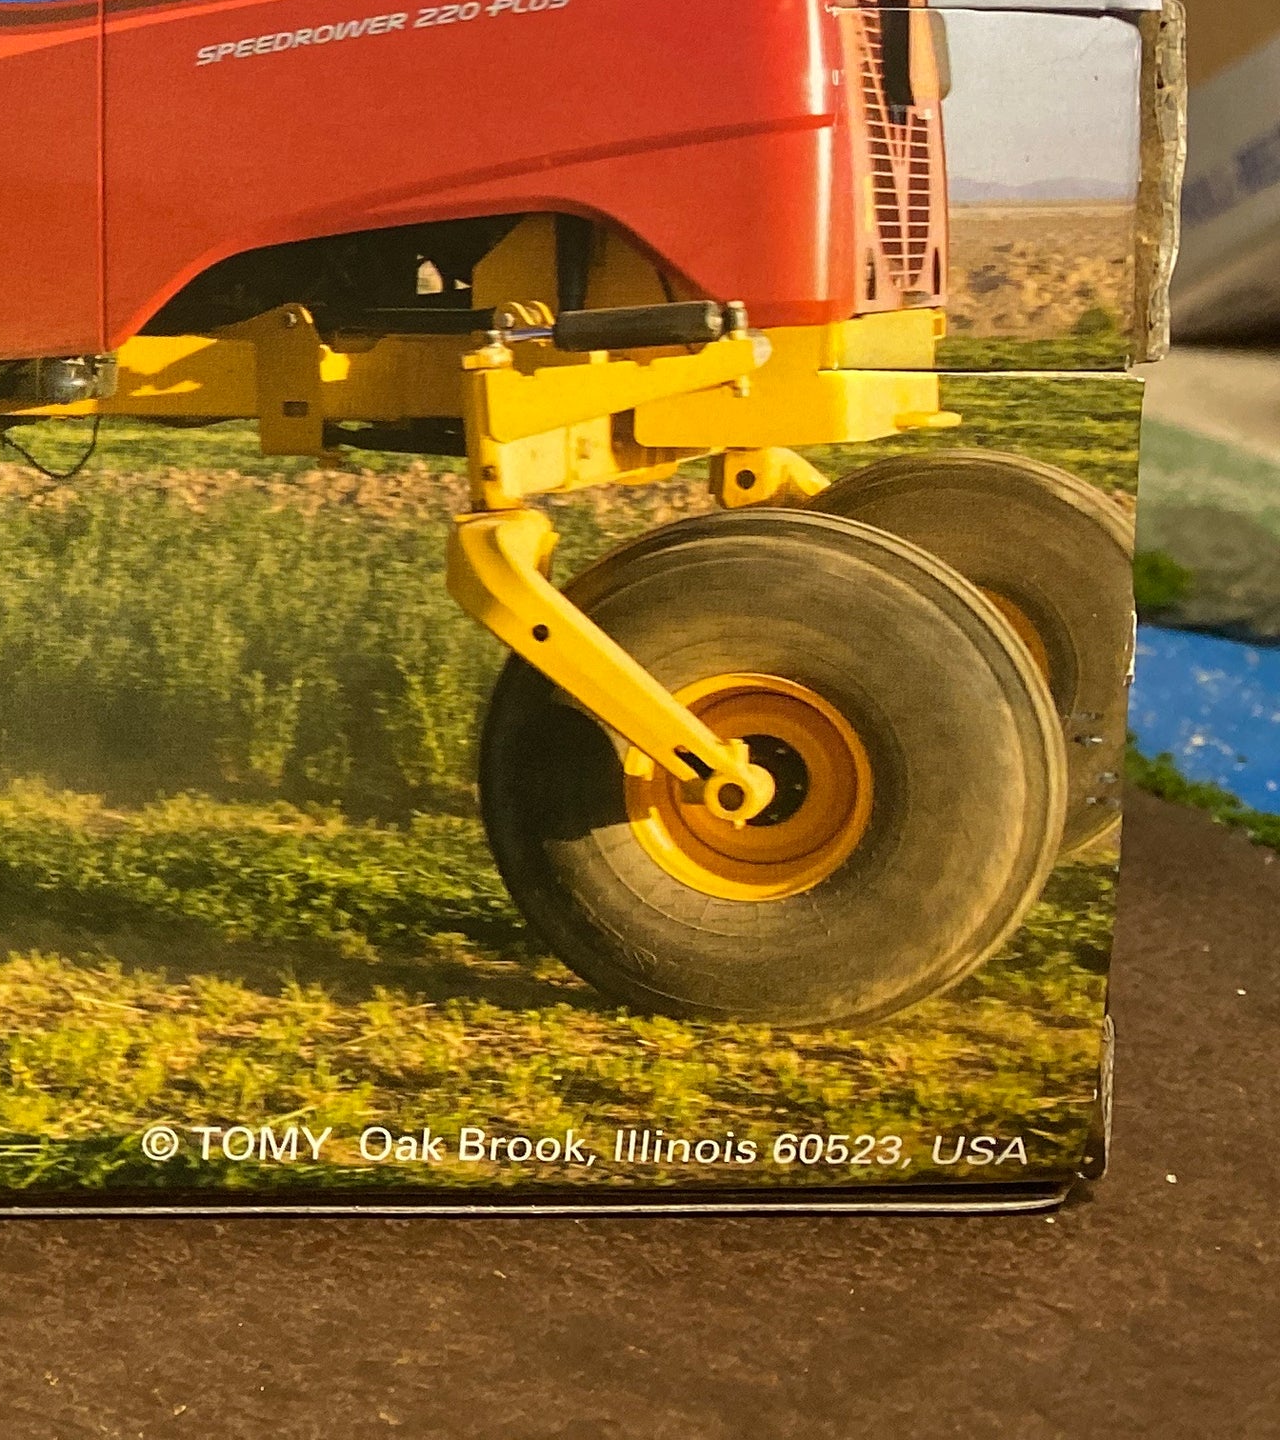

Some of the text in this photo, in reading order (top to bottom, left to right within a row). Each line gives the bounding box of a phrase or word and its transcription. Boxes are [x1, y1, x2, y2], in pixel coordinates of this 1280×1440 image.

[195, 12, 408, 66] SPEEDROWER
[413, 2, 481, 29] 220
[191, 1126, 333, 1161] TOMY
[359, 1126, 444, 1162] Oak
[458, 1127, 597, 1166] Brook,
[614, 1129, 758, 1164] Illinois
[772, 1133, 913, 1169] 60523,
[932, 1135, 1028, 1166] USA
